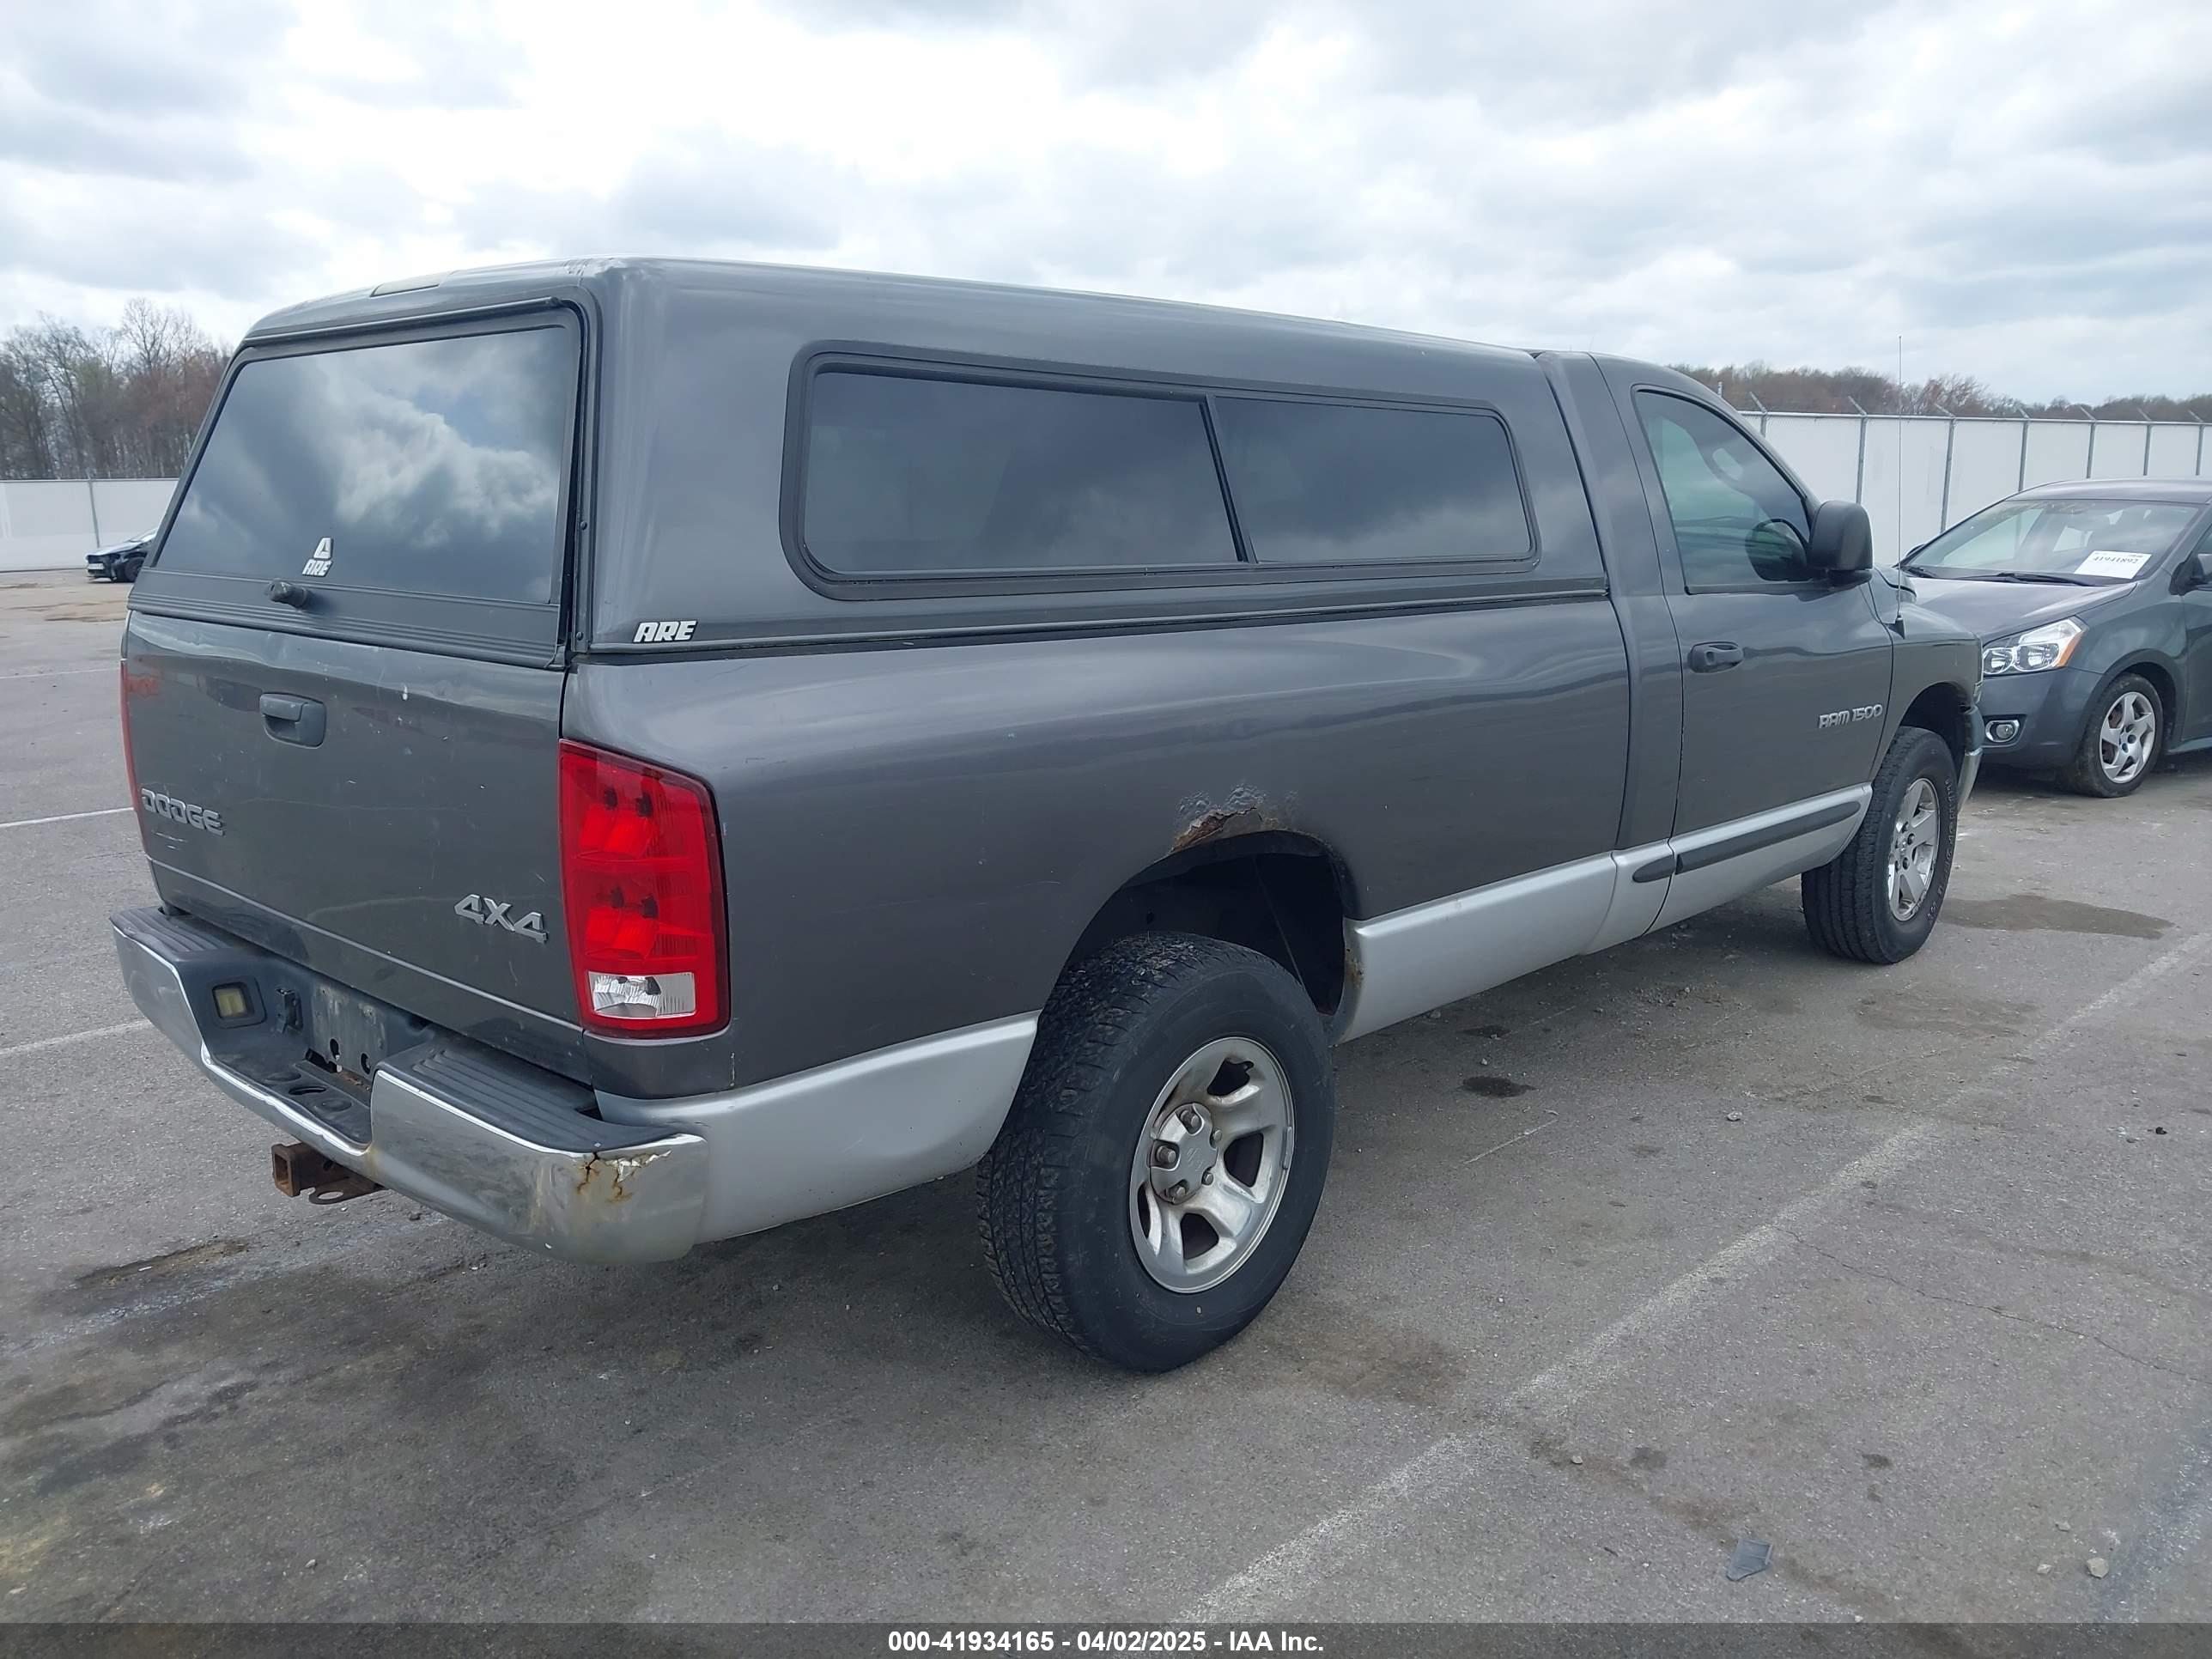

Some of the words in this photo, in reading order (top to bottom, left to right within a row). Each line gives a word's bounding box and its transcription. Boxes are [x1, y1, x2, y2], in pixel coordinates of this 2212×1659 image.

[301, 559, 332, 576] ARE
[633, 620, 697, 642] ARE
[1819, 710, 1850, 729] RAM
[1851, 704, 1883, 722] 1500
[141, 787, 224, 836] DODGE
